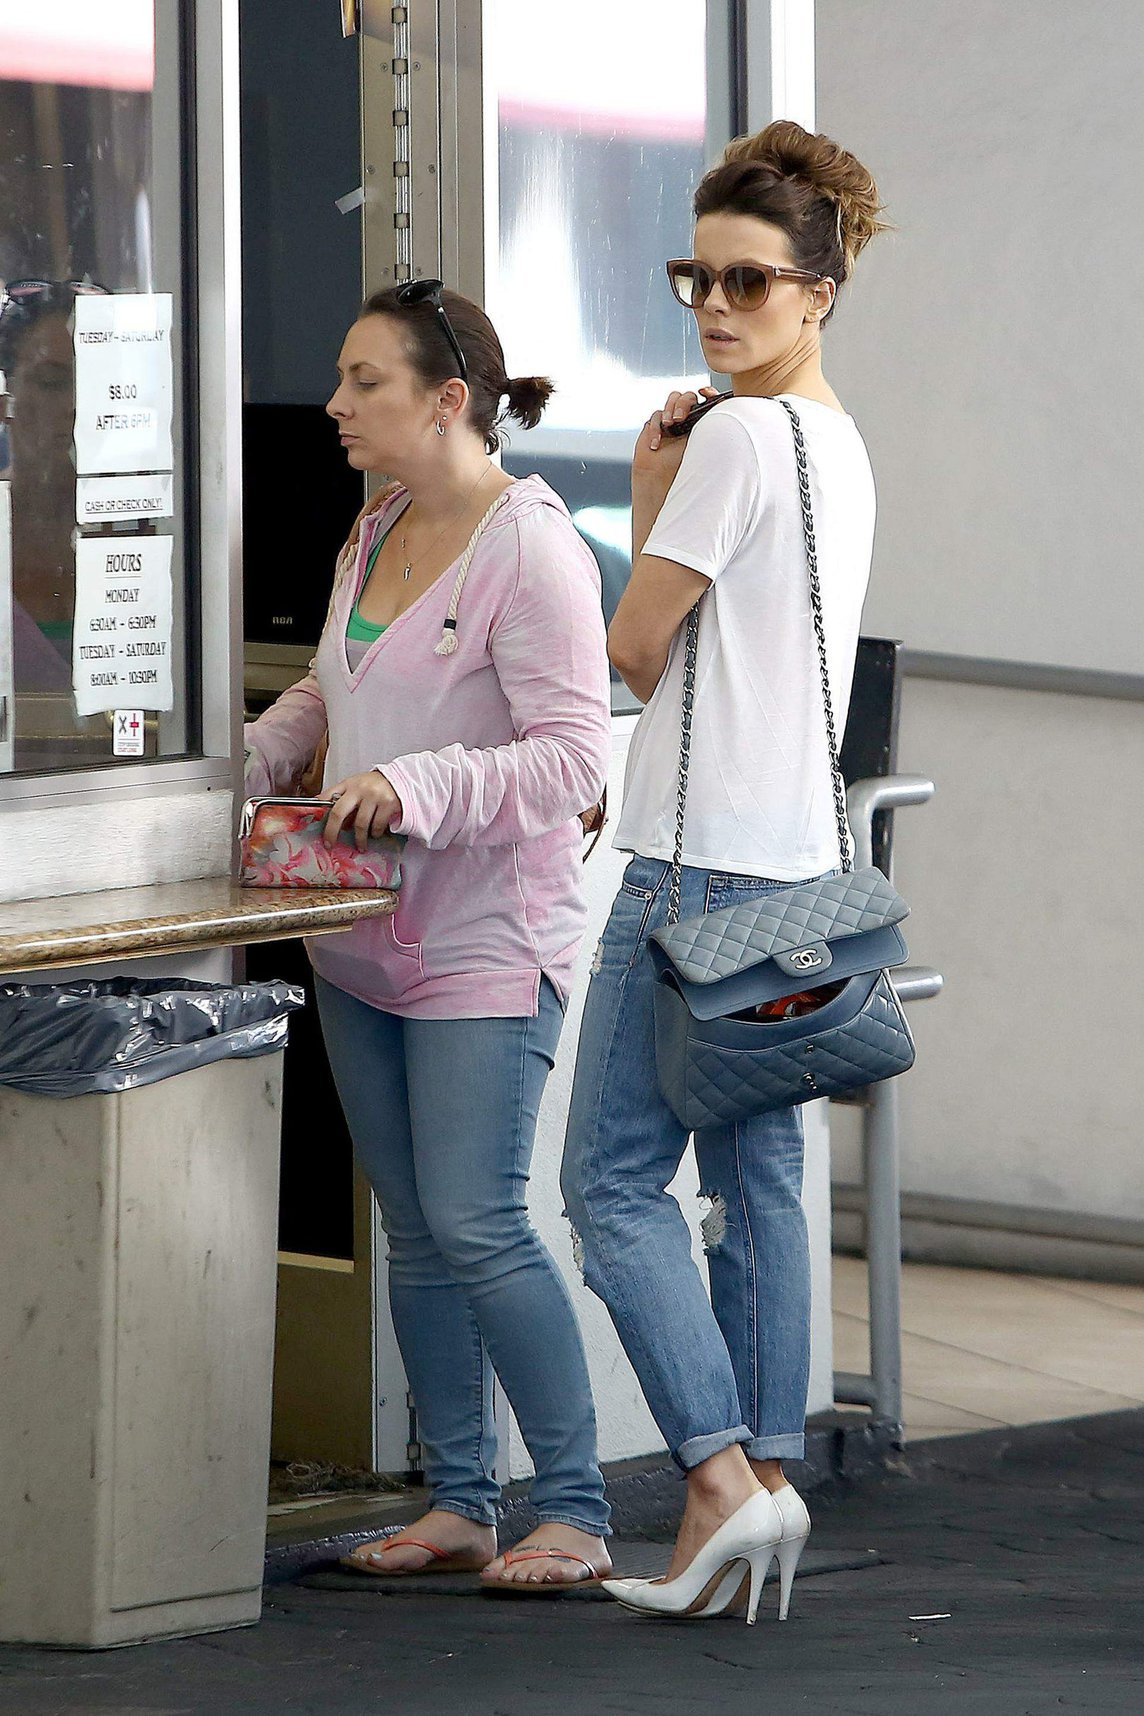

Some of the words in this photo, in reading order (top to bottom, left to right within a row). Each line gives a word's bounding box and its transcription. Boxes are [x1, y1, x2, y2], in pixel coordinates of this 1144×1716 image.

[79, 331, 113, 343] TUESDAY
[109, 384, 137, 400] $8.00
[96, 415, 128, 430] AFTER
[85, 501, 104, 512] CASH
[105, 500, 116, 510] OR
[116, 499, 141, 510] CHECK
[105, 554, 142, 573] HOURS
[105, 588, 140, 603] MONDAY
[272, 616, 293, 625] RCA
[79, 644, 116, 660] TUESDAY
[126, 641, 167, 656] SATURDAY
